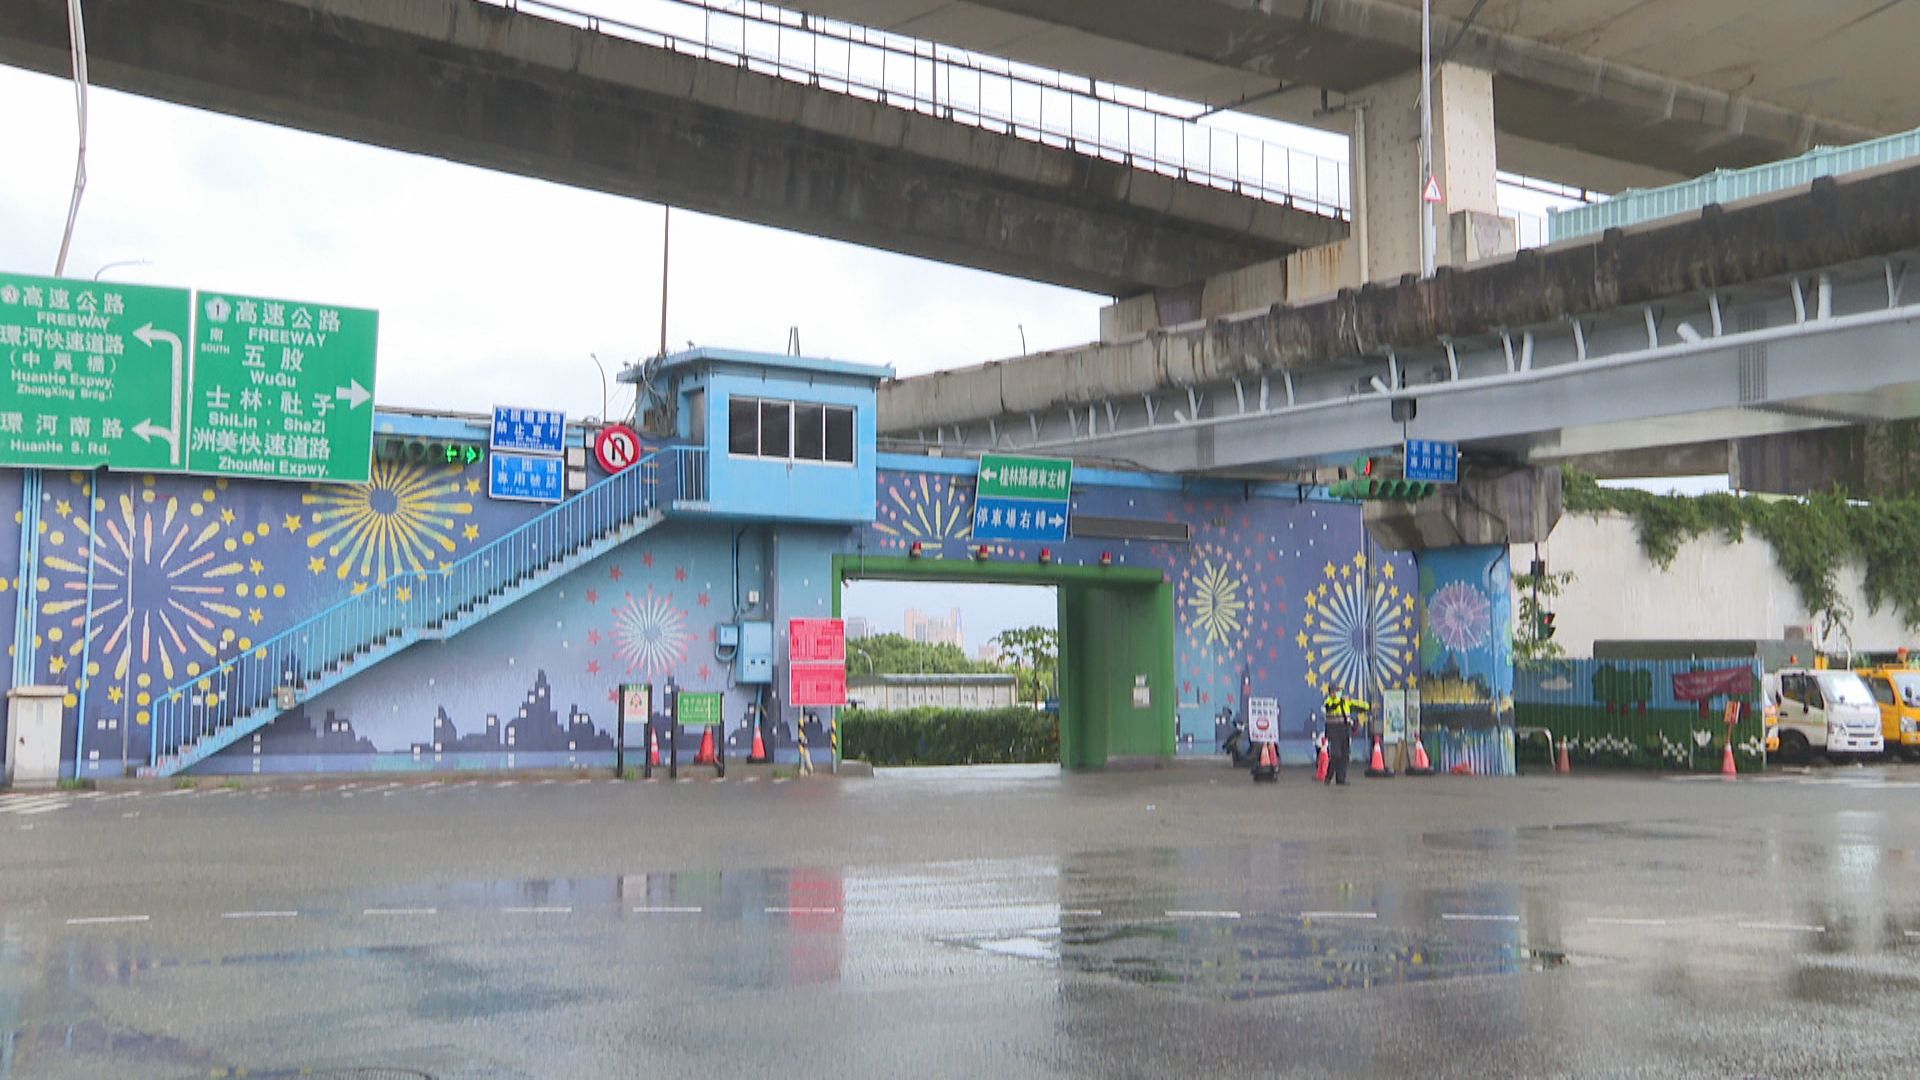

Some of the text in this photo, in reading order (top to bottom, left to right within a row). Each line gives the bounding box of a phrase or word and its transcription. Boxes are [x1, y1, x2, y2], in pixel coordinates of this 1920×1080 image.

[23, 286, 125, 315] 高速公路
[37, 311, 110, 330] FREEWAY
[235, 299, 341, 333] 高速公路
[248, 327, 326, 348] FREEWAY
[242, 344, 304, 372] 五股
[11, 369, 66, 385] HuanHe
[250, 370, 297, 388] WuGu
[208, 411, 325, 434] ShiLin SheZi
[11, 440, 63, 452] HuanHe
[192, 427, 331, 460] 洲美快速道路
[218, 455, 275, 473] ZhouMei
